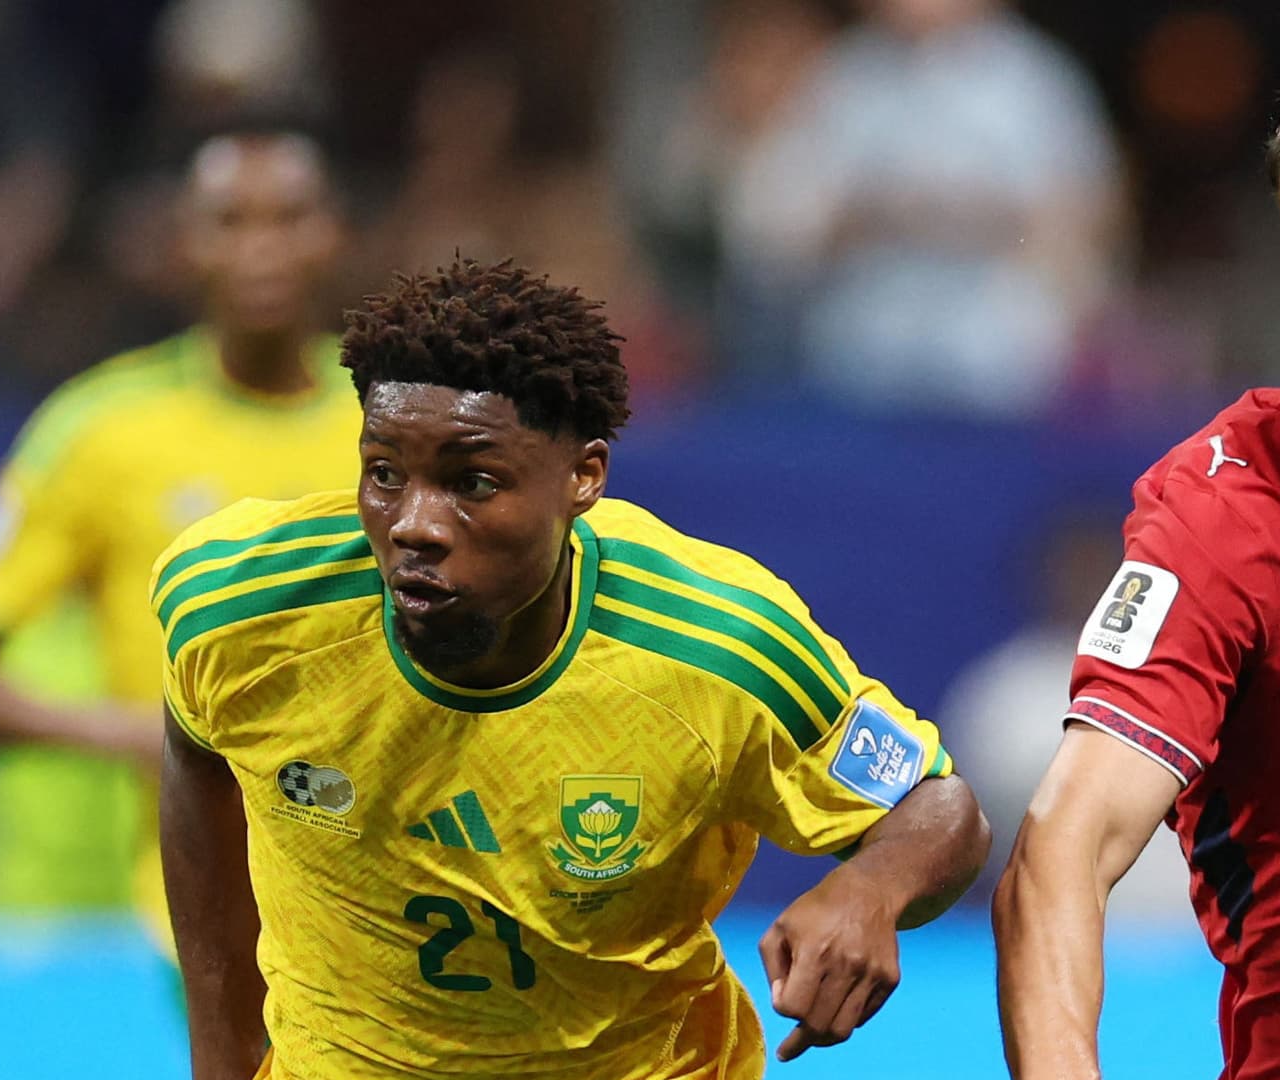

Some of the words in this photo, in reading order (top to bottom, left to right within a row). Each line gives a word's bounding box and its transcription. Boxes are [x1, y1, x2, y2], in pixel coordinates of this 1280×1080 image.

[880, 742, 907, 787] PEACE
[271, 806, 308, 824] FOOTBALL
[309, 818, 360, 838] ASSOCIATION
[286, 804, 312, 816] SOUTH
[564, 863, 595, 879] SOUTH
[596, 863, 630, 879] AFRICA
[404, 895, 536, 992] 21
